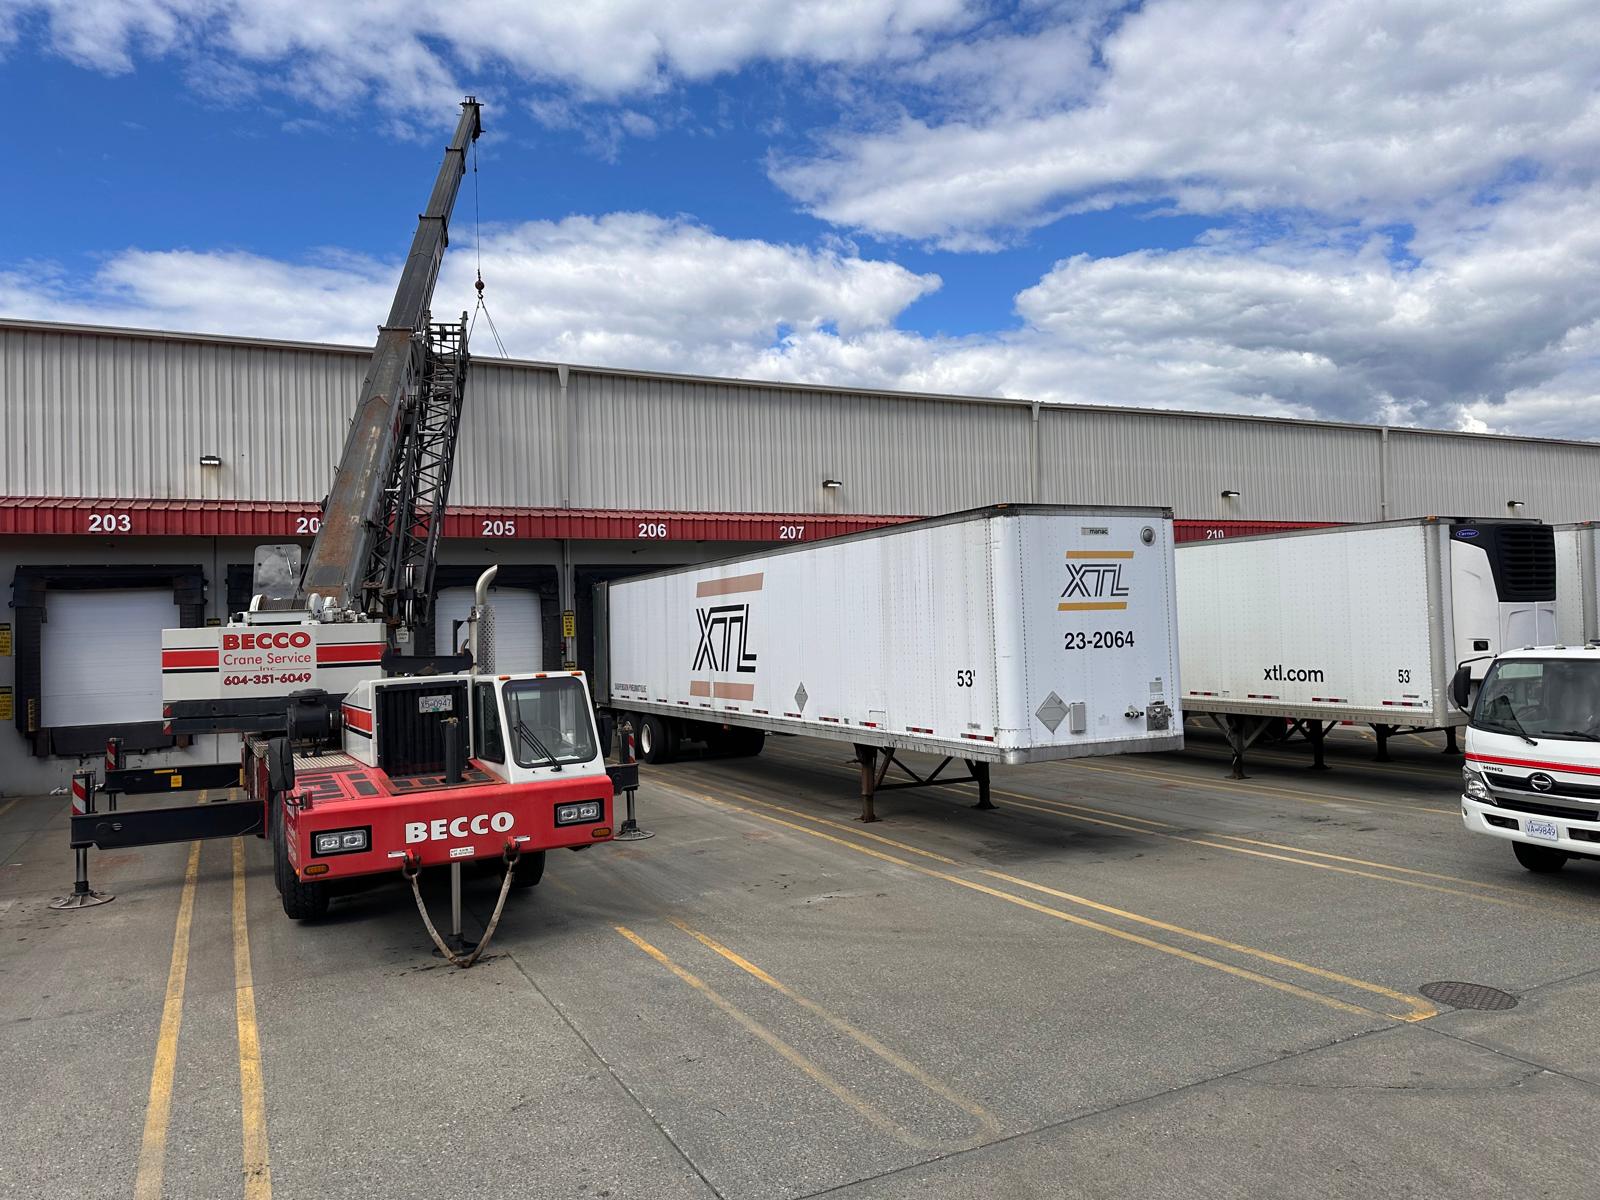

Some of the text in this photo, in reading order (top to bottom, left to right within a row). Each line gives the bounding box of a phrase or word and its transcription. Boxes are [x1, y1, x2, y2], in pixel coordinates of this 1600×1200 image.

[88, 514, 131, 531] 203
[296, 517, 321, 533] 20
[482, 520, 515, 535] 205
[638, 523, 666, 537] 206
[780, 525, 804, 539] 207
[1206, 529, 1224, 539] 210
[1061, 563, 1129, 597] XTL
[223, 632, 311, 650] BECCO
[692, 603, 757, 672] XTL
[1064, 631, 1134, 650] 23-2064
[223, 652, 311, 666] Crane Service
[223, 673, 312, 686] 604-351-6049
[957, 670, 975, 687] 53'
[1264, 664, 1324, 682] xtl.com
[405, 812, 514, 843] BECCO
